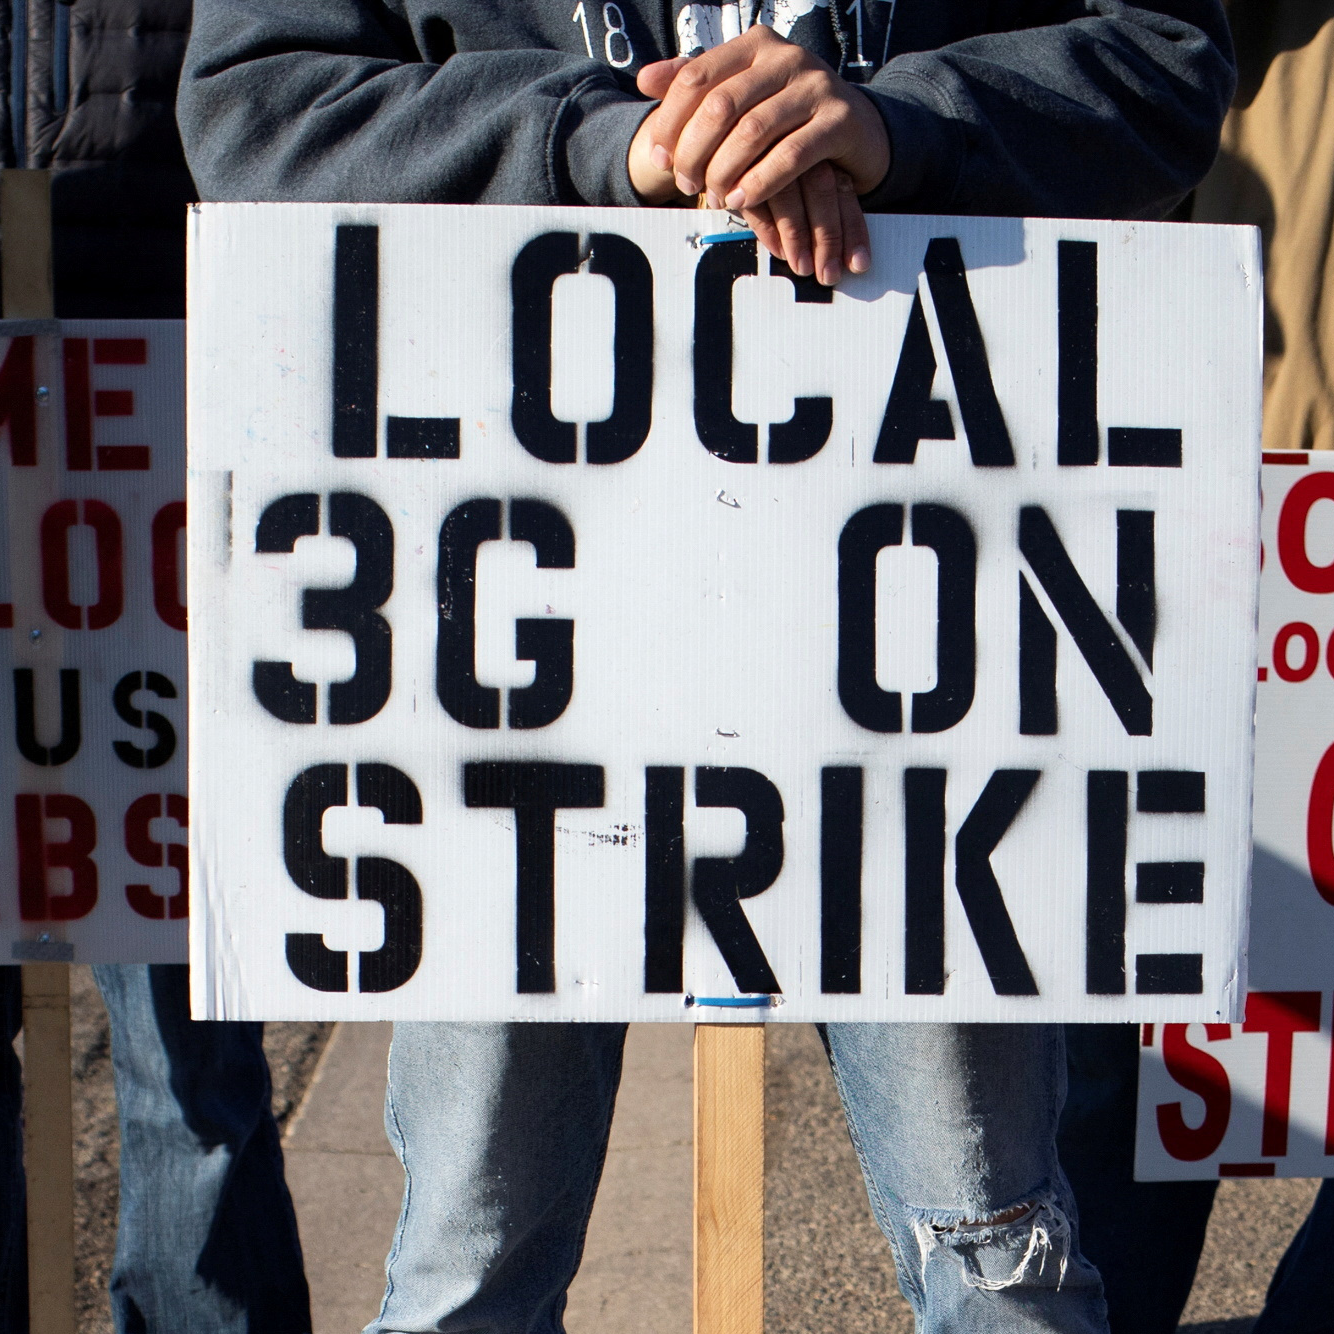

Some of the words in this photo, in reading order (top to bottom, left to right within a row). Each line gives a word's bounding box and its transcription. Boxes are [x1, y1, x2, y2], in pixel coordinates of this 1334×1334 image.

[572, 1, 634, 69] 18
[332, 224, 1184, 466] LOCAL
[12, 666, 179, 771] US
[252, 492, 576, 728] 3G
[837, 502, 1156, 736] ON
[283, 761, 1206, 995] STRIKE
